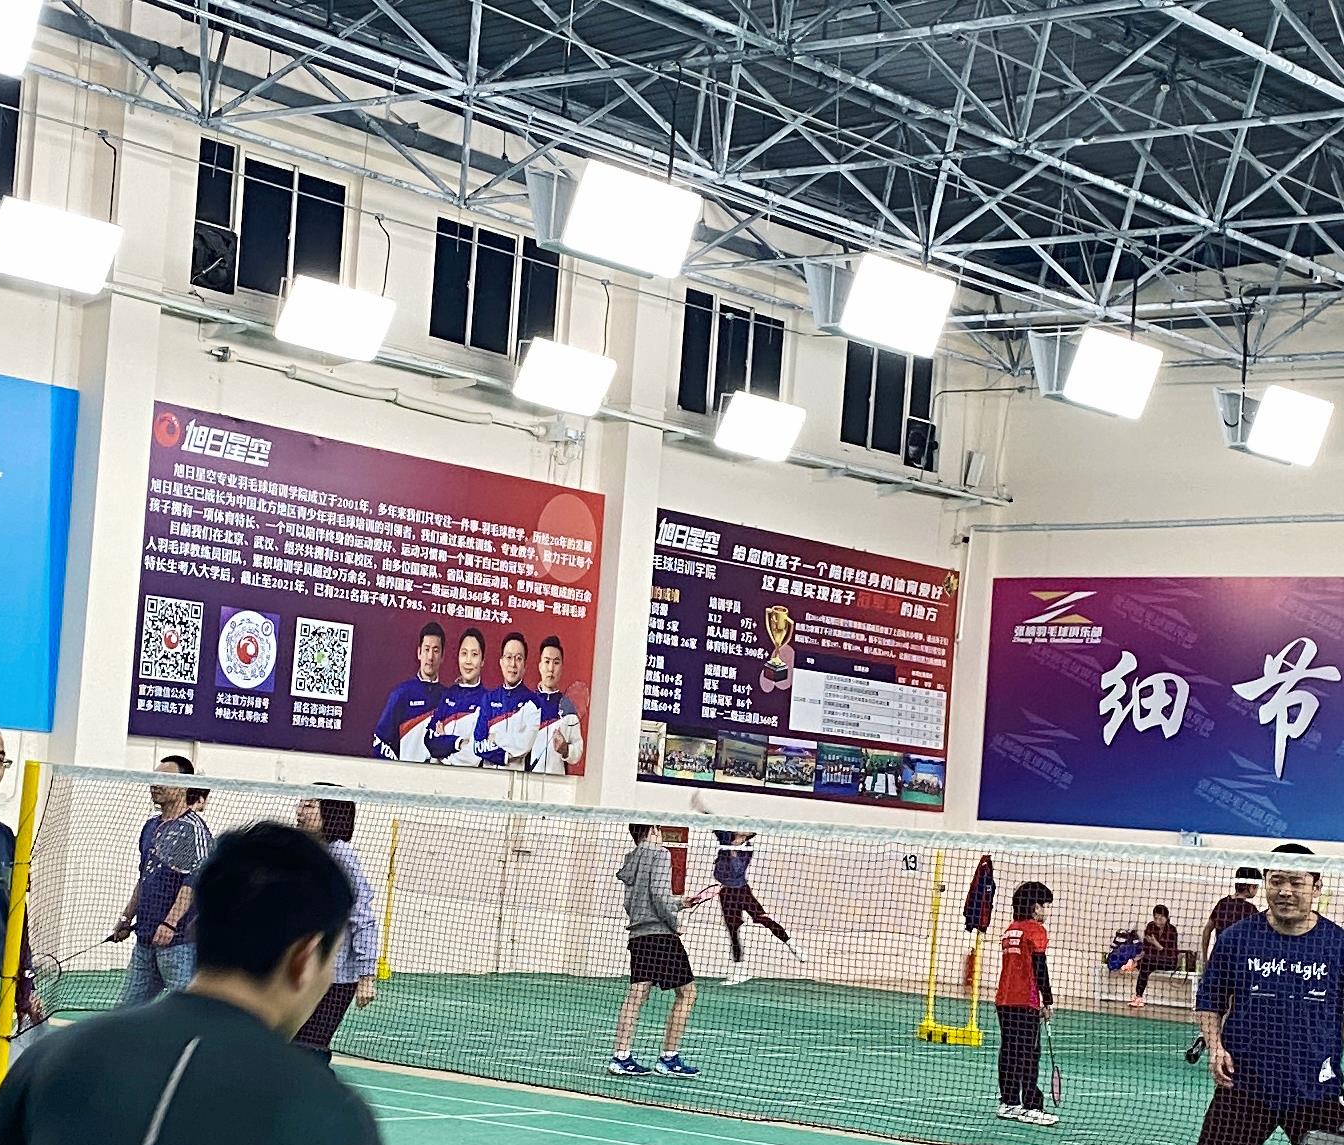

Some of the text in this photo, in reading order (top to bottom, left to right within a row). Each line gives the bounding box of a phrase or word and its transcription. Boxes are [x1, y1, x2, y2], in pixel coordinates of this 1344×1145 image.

[181, 418, 272, 467] 旭日星空
[656, 517, 721, 556] 旭日星空
[646, 654, 665, 669] 力量
[1099, 637, 1342, 779] 细节
[903, 855, 917, 870] 13
